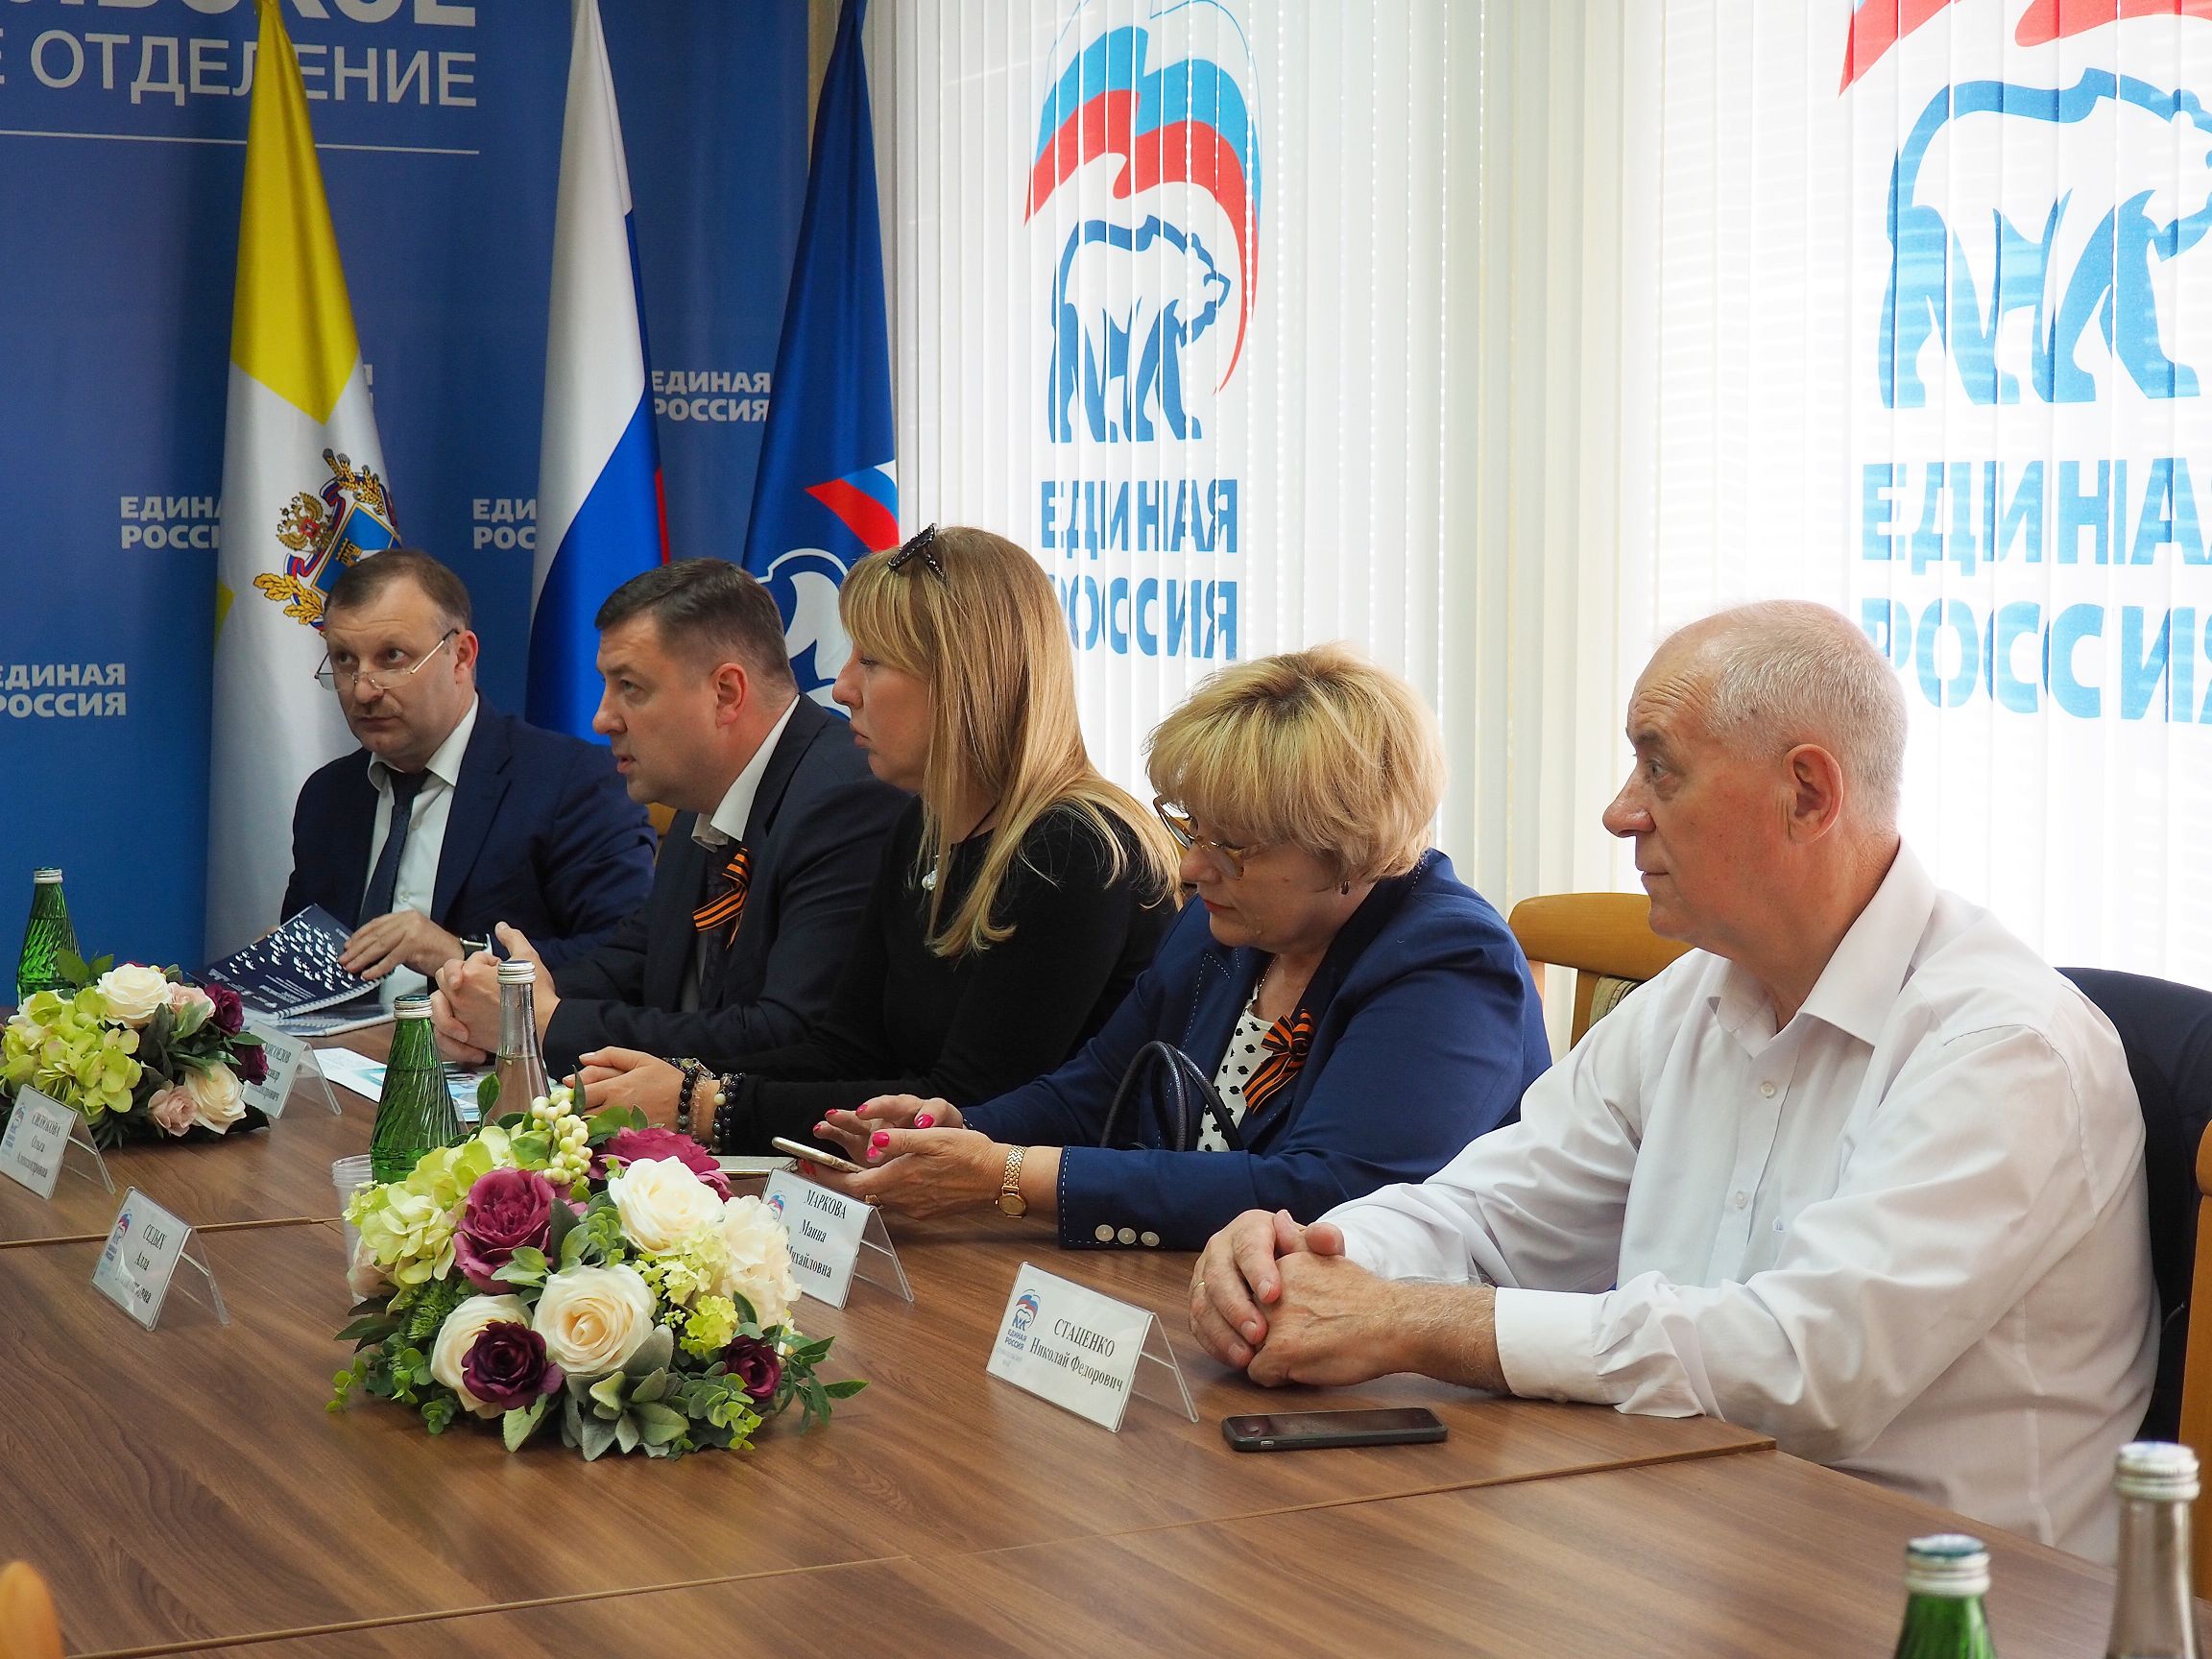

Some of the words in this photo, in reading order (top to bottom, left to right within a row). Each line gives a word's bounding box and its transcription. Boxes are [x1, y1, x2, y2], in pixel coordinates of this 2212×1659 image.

[30, 29, 477, 107] ОТДЕЛЕНИЕ
[651, 371, 771, 396] ЕДИНАЯ
[1041, 479, 1238, 560] ЕДИНАЯ
[1861, 457, 2212, 577] ЕДИНА
[0, 662, 126, 690] ДИНАЯ
[1861, 597, 2212, 725] РОССИ
[803, 1189, 848, 1219] МАРКОВА
[1004, 1336, 1024, 1352] РОССИЯ
[1007, 1329, 1028, 1342] ЕДИНАЯ
[1053, 1318, 1116, 1358] СТАЦЕНКО
[1029, 1336, 1070, 1368] Николай
[1070, 1353, 1124, 1392] Федорович
